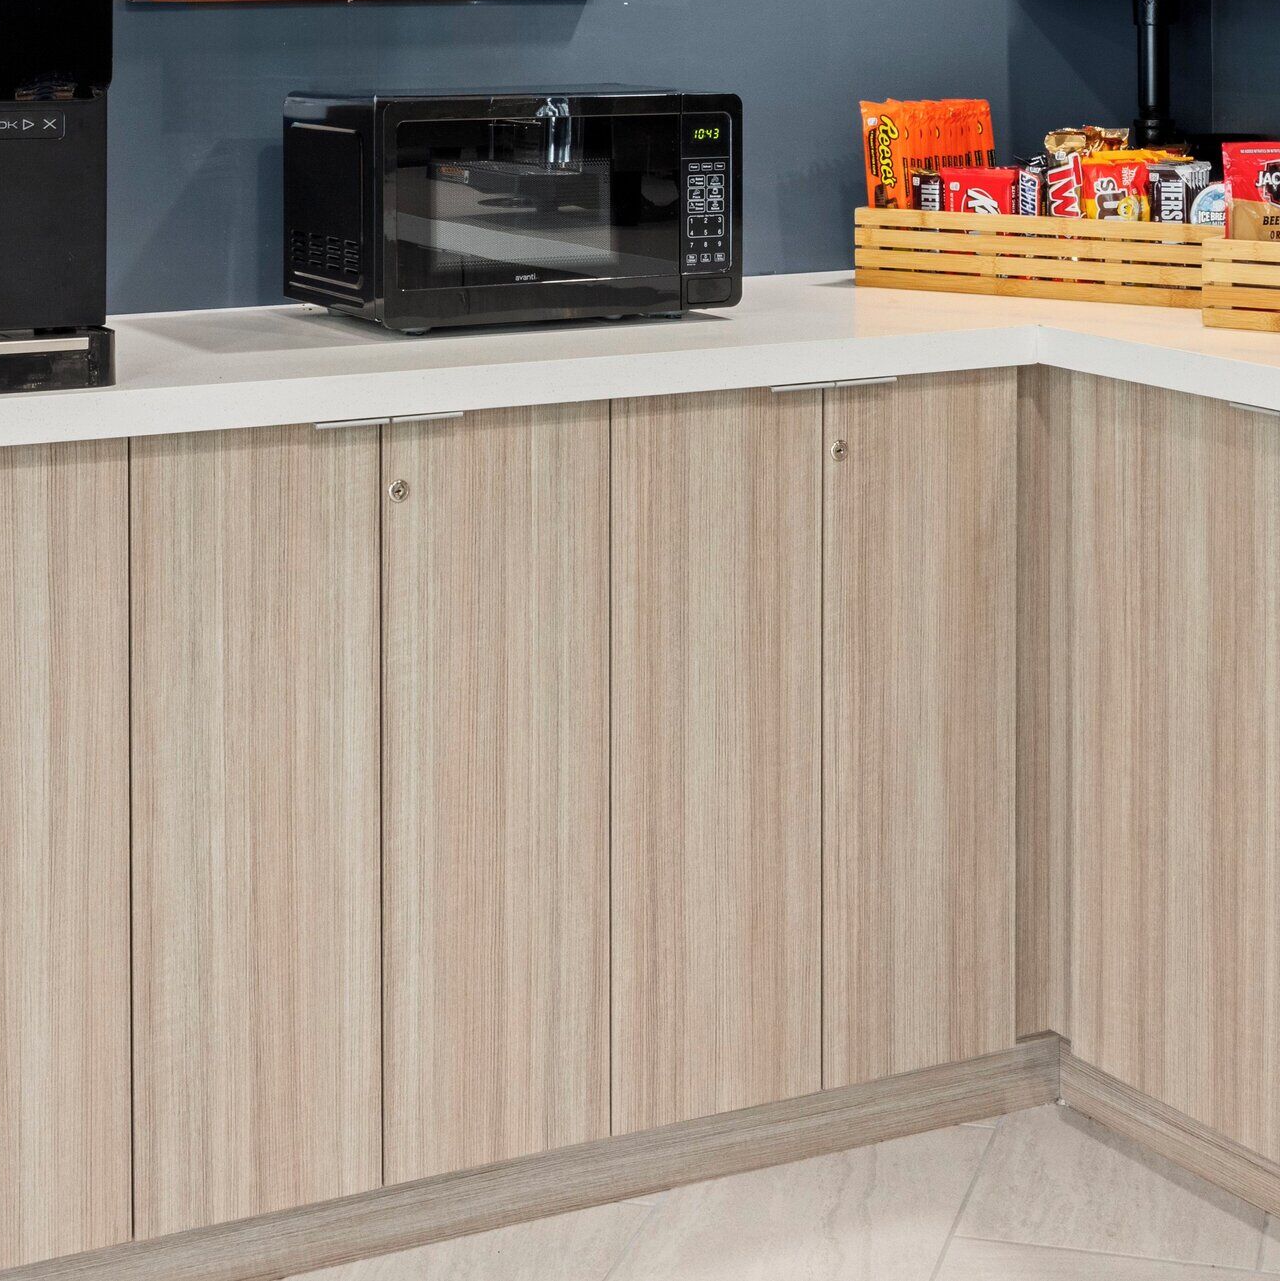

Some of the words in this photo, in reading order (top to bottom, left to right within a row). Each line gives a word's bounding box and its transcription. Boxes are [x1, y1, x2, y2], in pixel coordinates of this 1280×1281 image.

[878, 114, 899, 188] Reese's
[1020, 173, 1037, 216] SNICK
[1161, 182, 1183, 223] HERS
[1198, 211, 1211, 224] ICE
[1210, 211, 1226, 222] BREA
[515, 273, 536, 281] avanti
